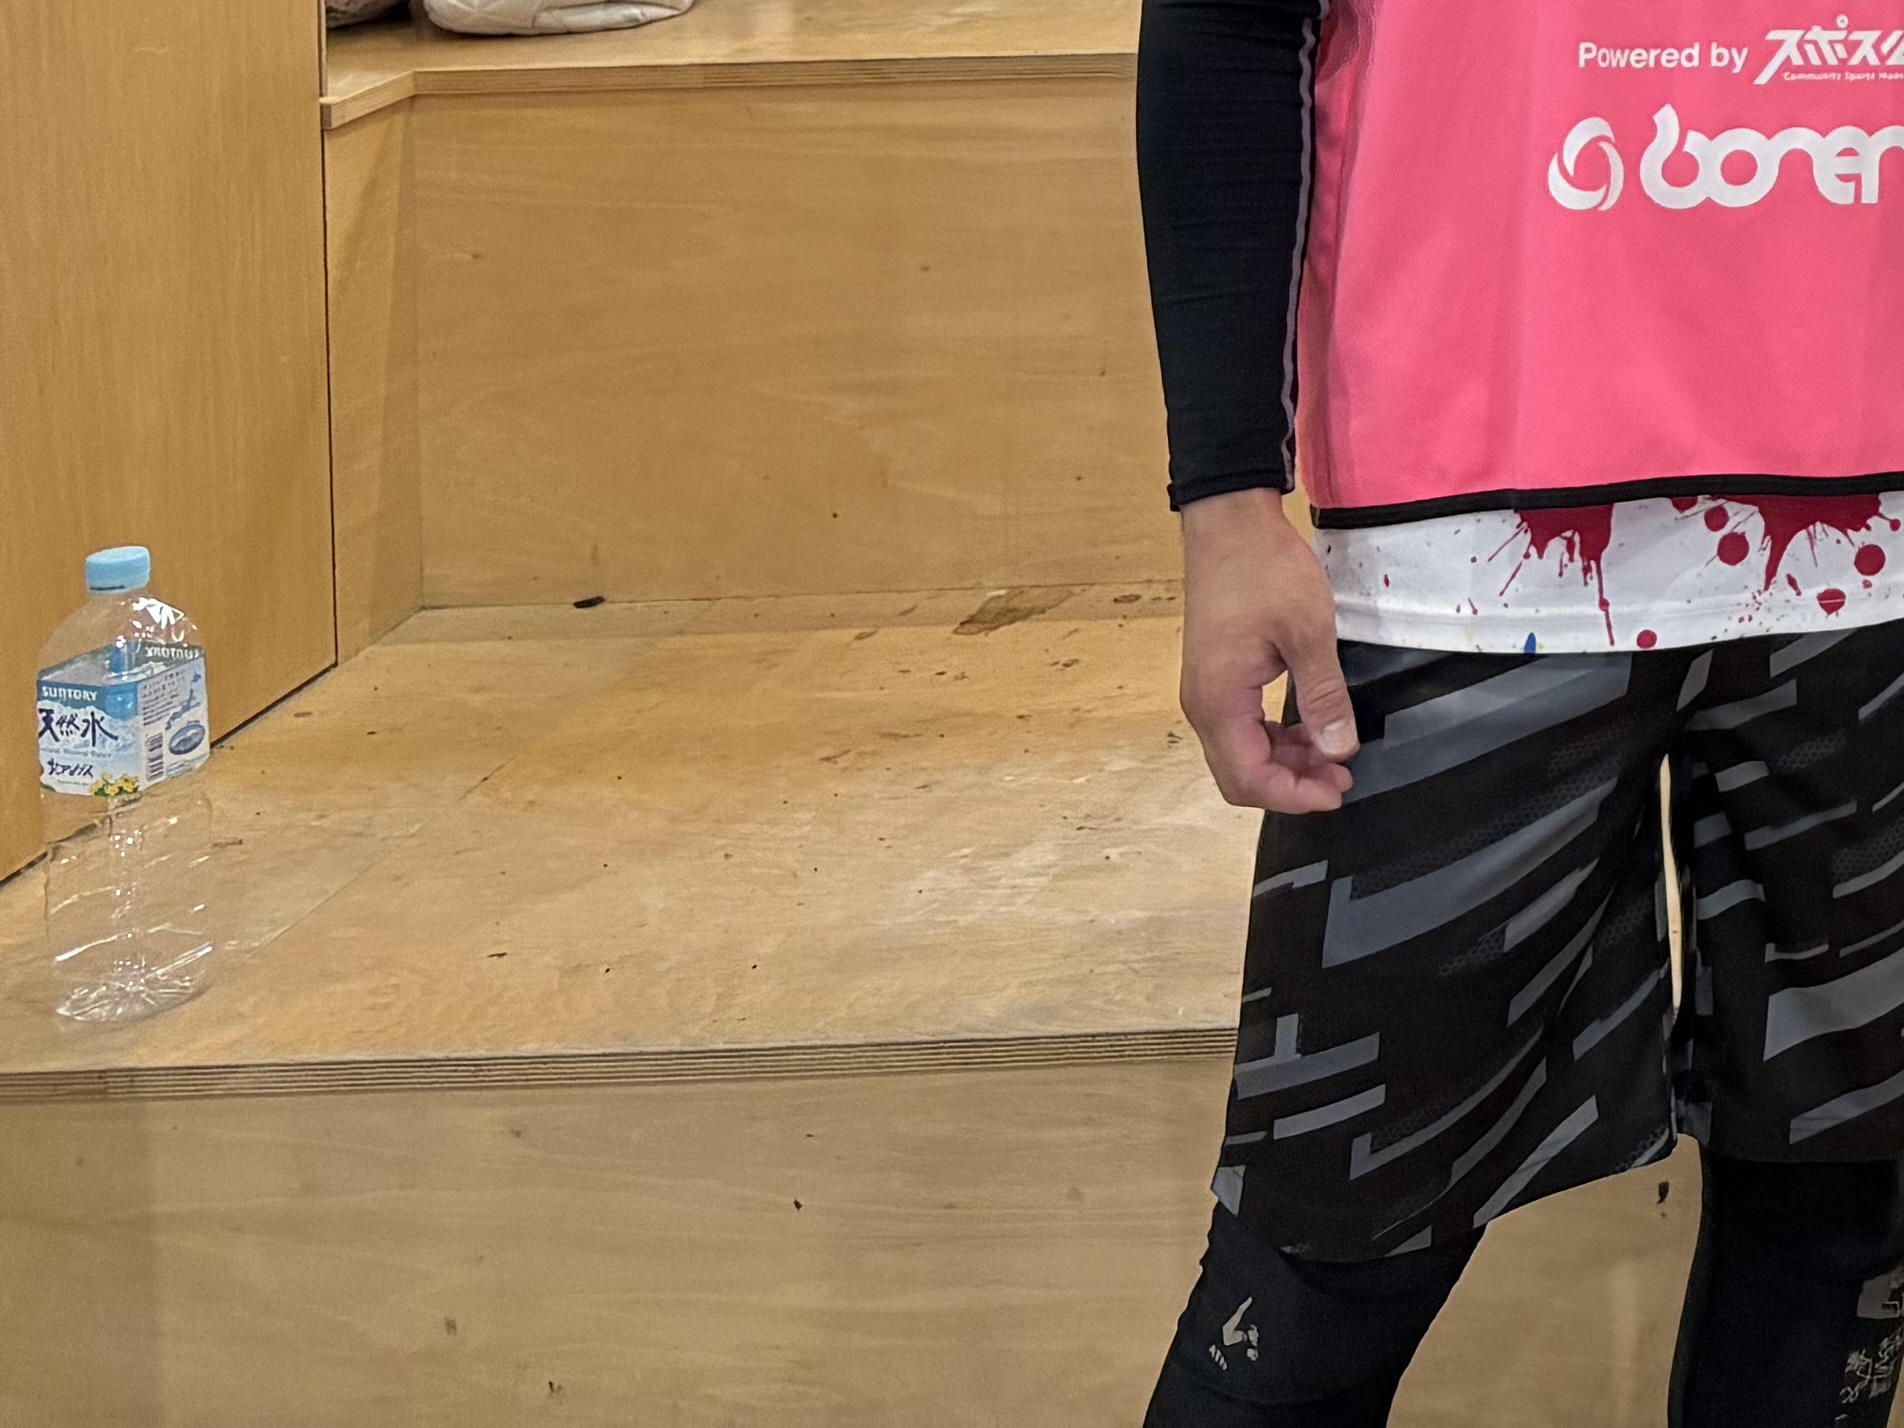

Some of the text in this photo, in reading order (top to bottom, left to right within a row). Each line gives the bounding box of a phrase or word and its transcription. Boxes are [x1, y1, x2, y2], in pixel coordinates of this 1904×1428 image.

[1578, 41, 1700, 69] Powered
[1710, 40, 1748, 74] by
[38, 708, 119, 747] 天然水
